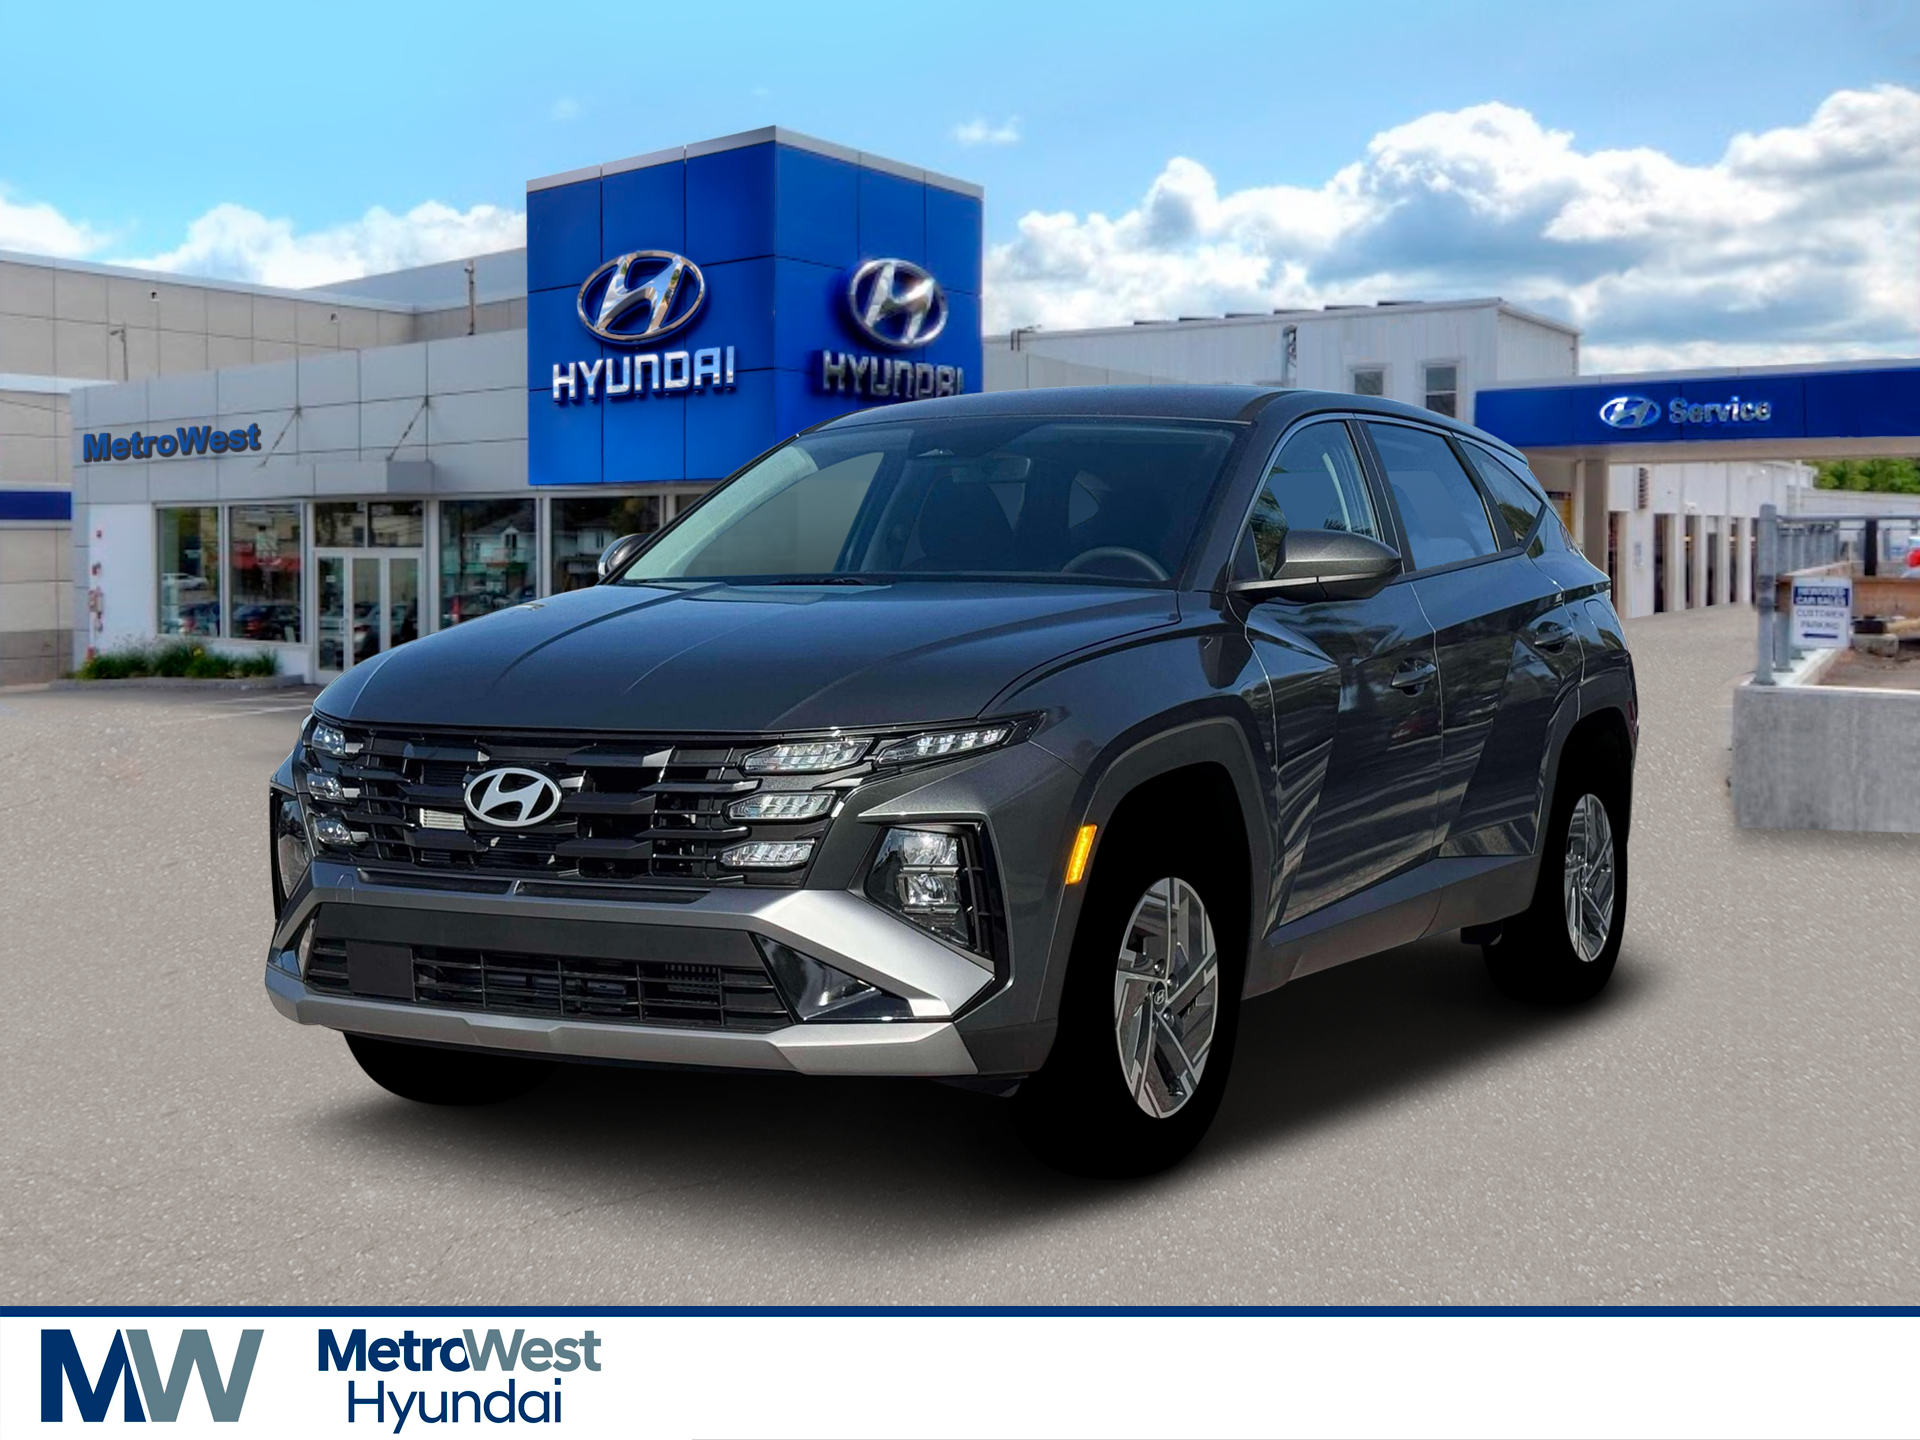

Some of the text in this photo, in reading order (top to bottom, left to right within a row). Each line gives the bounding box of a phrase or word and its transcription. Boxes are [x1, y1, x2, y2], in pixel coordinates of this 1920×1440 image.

[553, 346, 735, 399] HYUNDAI
[823, 350, 964, 400] HYUNDAI
[1669, 396, 1771, 424] Service
[83, 423, 261, 462] MetroWest
[1796, 609, 1844, 618] CUSTOMER
